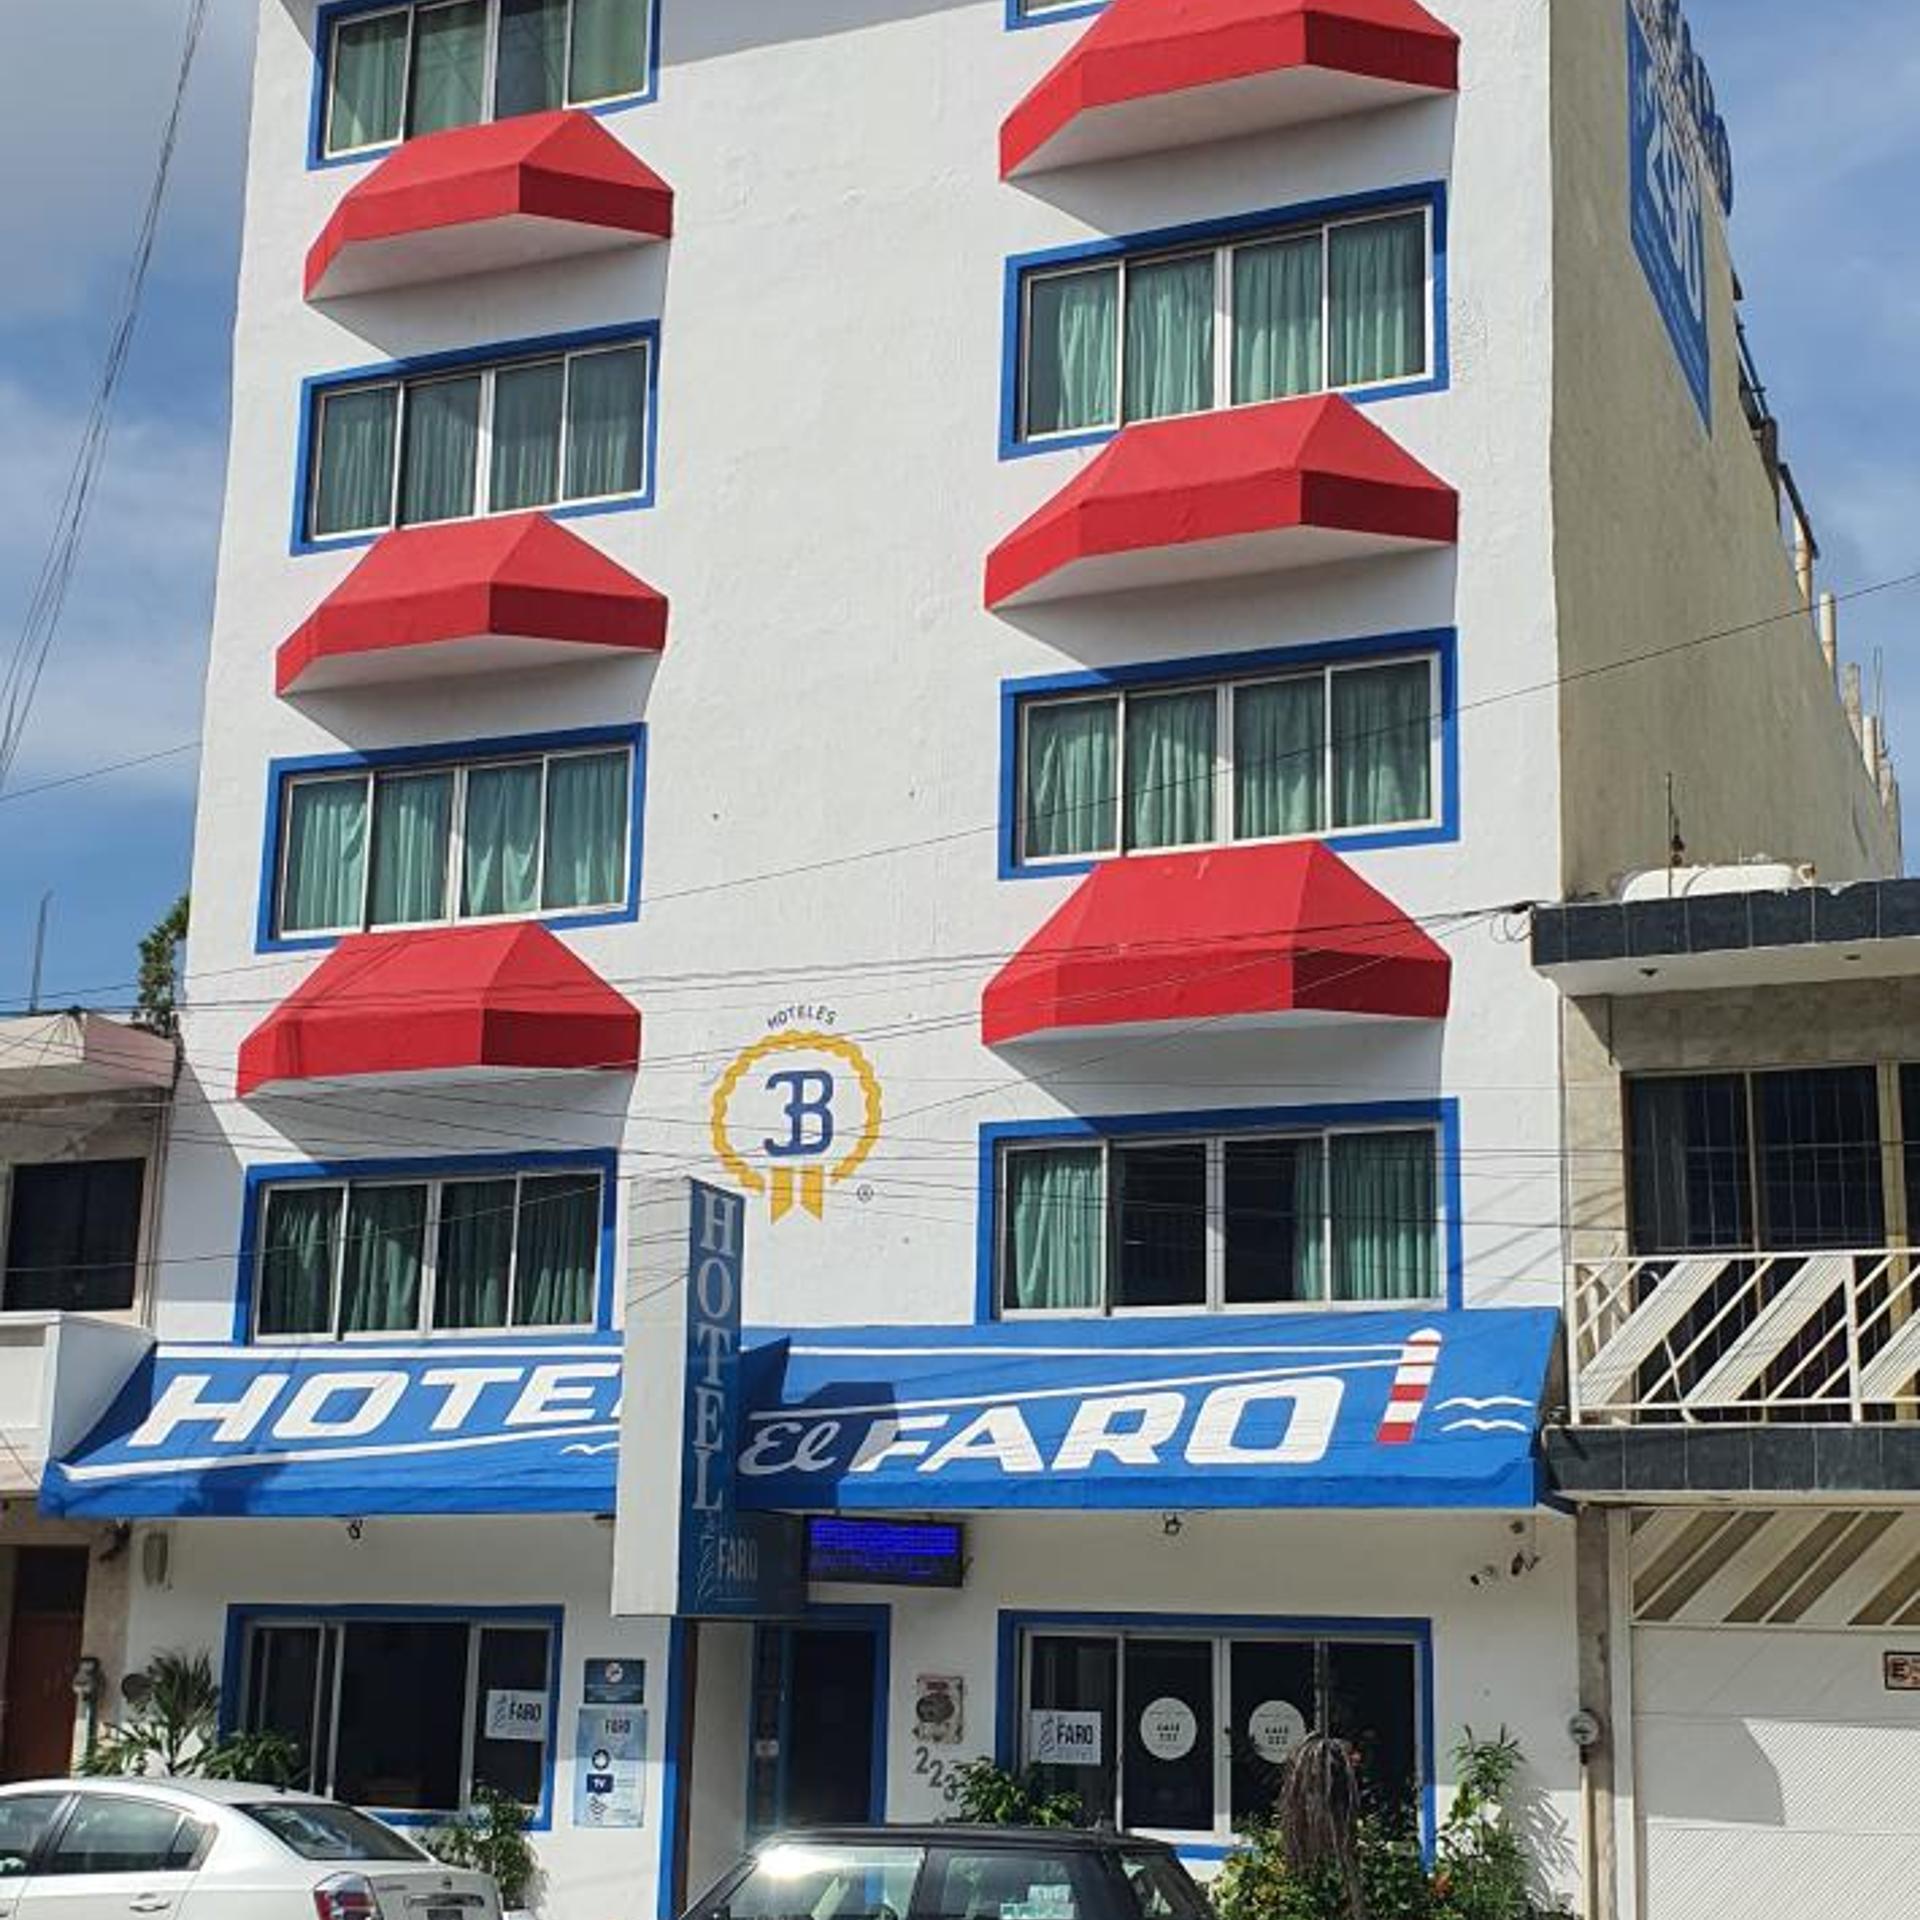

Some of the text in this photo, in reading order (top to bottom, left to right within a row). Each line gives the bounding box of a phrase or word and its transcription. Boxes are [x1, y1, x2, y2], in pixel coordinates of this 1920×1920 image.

[767, 1005, 837, 1029] HOTELES
[691, 1190, 737, 1513] HOTEL
[126, 1362, 621, 1448] HOTE
[738, 1375, 1346, 1477] El FARO
[717, 1536, 759, 1583] FARO
[508, 1702, 542, 1722] FARO
[1057, 1724, 1093, 1745] FARO
